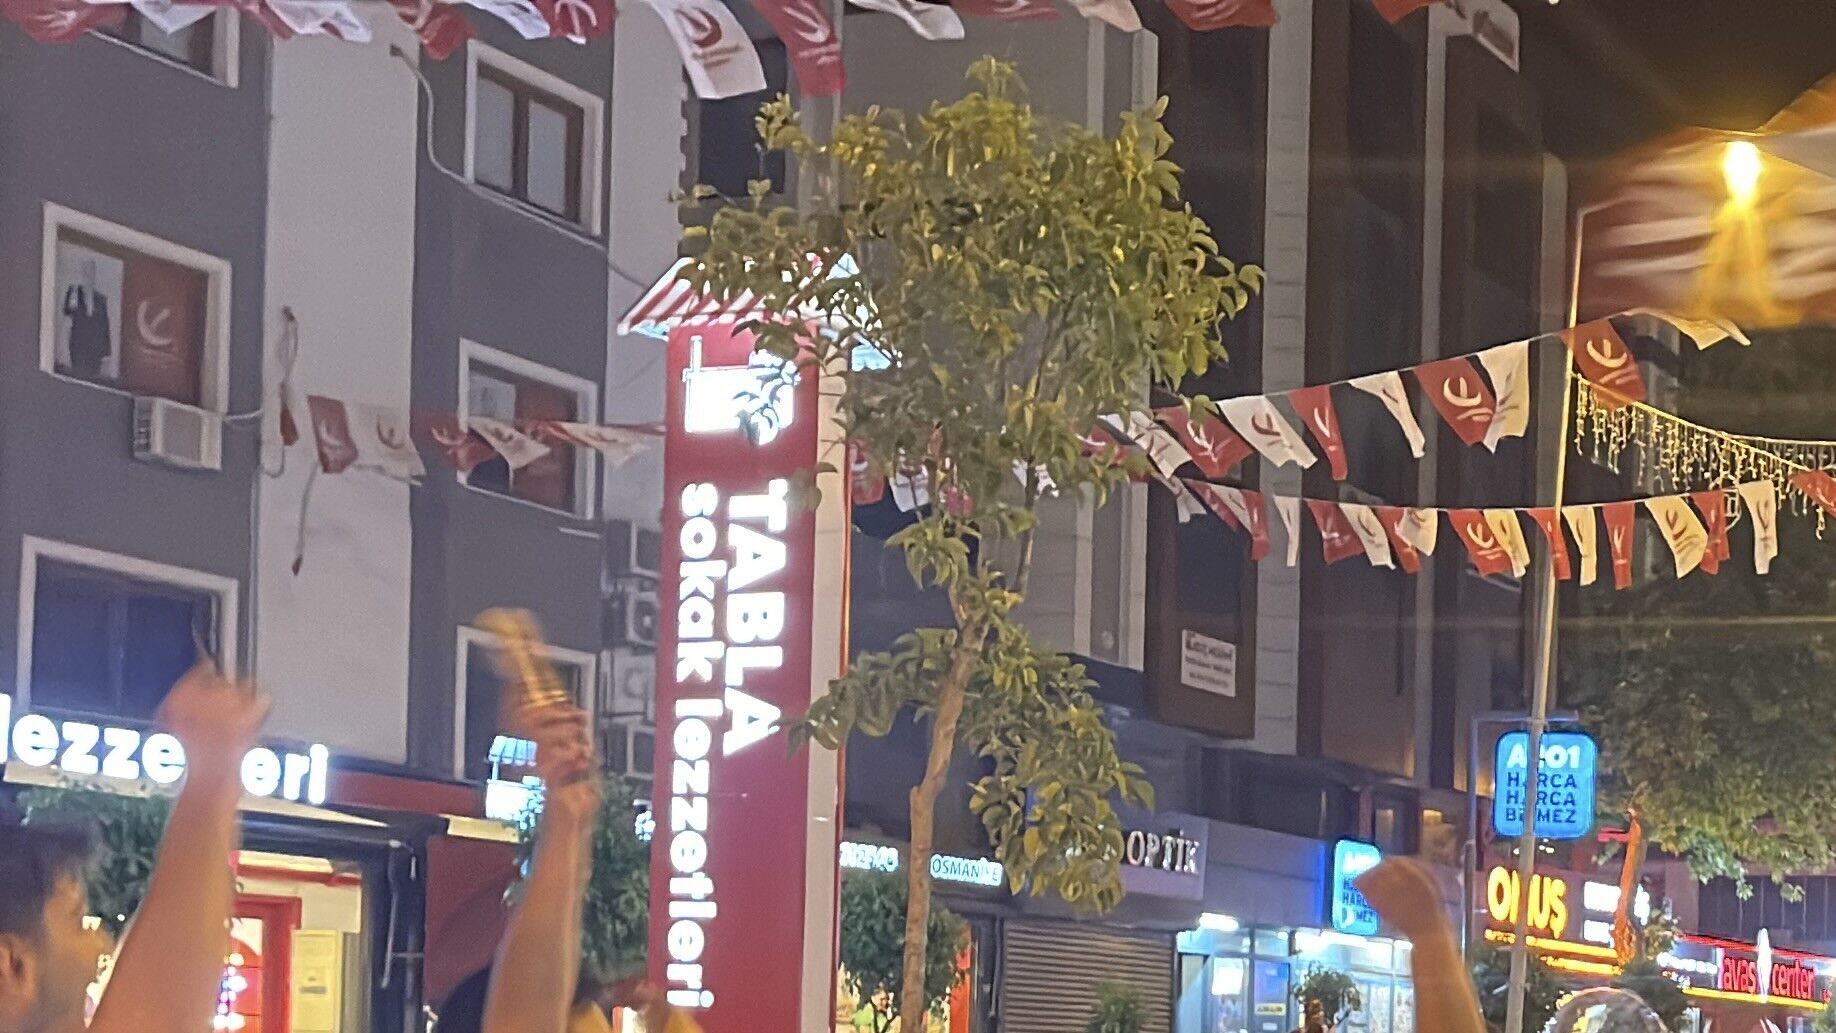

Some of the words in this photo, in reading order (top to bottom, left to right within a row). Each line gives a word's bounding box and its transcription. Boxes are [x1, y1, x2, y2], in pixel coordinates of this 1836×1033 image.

[676, 482, 727, 683] sokak
[722, 477, 789, 757] TABLA
[0, 693, 329, 805] lezzeeri
[1506, 790, 1576, 806] HRCA
[1507, 771, 1577, 788] HRCA
[666, 698, 724, 1009] lezzetleri
[1771, 958, 1817, 1000] center
